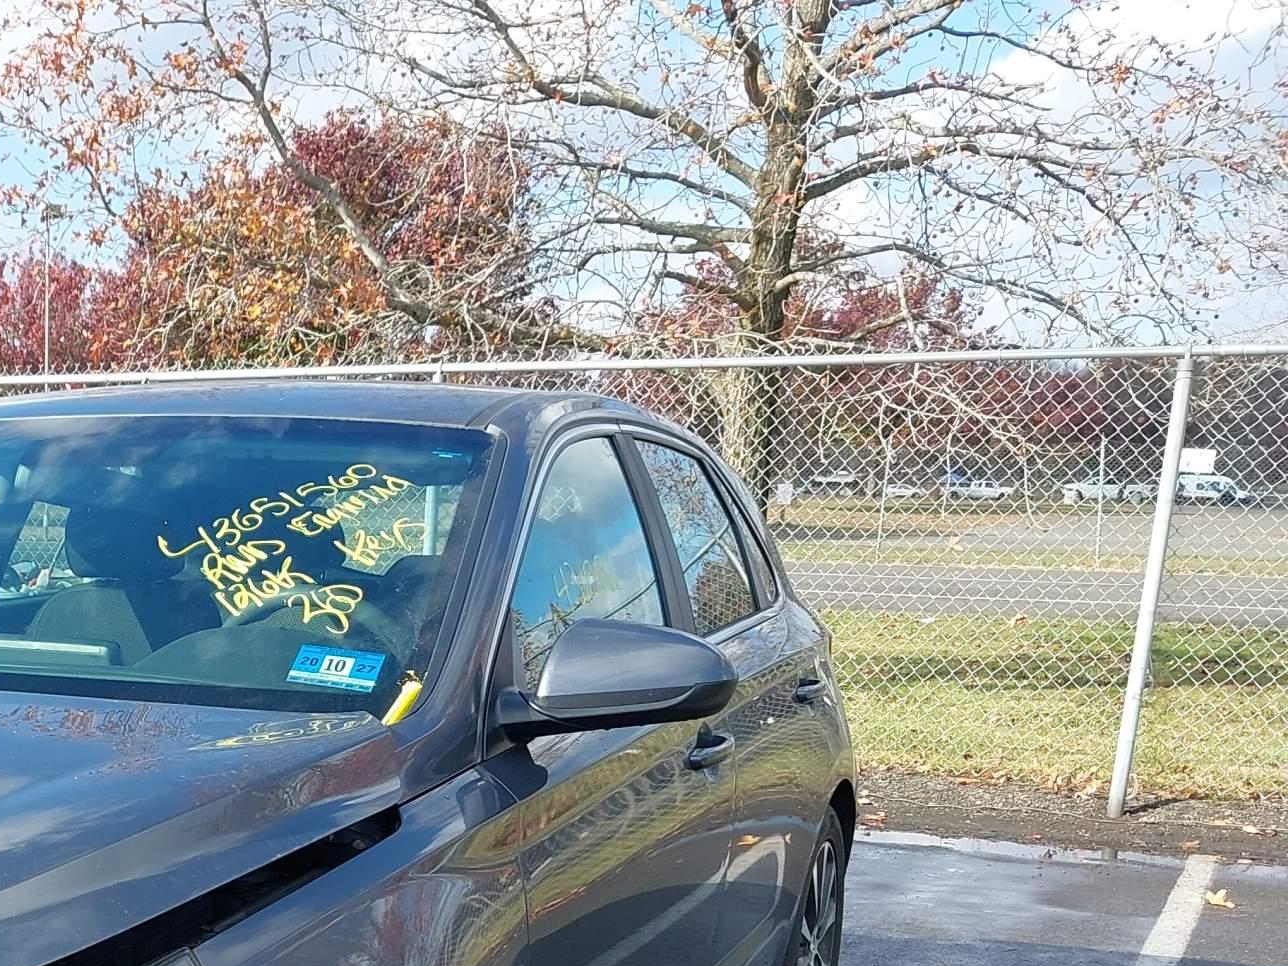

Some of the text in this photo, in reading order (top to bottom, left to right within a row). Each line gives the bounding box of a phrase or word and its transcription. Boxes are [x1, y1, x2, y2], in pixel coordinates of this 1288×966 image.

[157, 464, 377, 557] 43651560
[300, 656, 377, 674] 20 10 27
